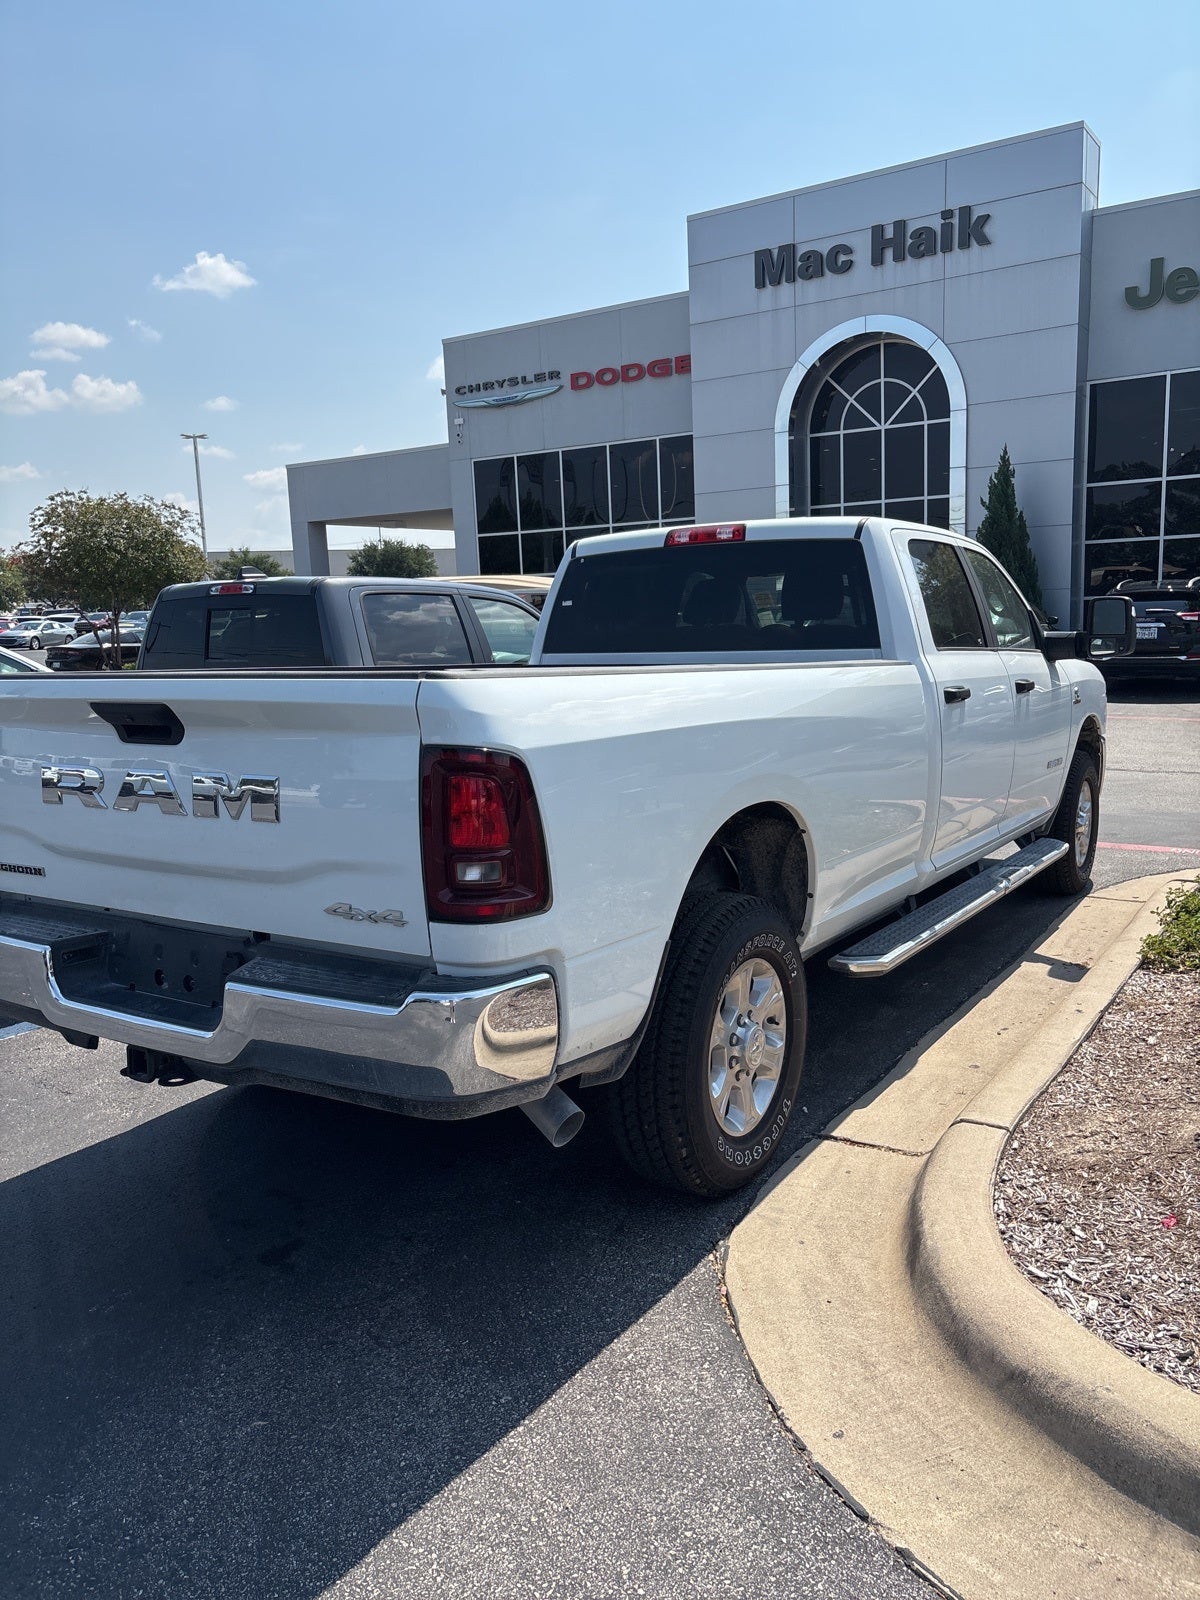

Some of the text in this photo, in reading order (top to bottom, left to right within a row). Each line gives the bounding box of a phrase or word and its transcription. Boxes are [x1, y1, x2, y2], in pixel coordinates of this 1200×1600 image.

[754, 205, 992, 290] Mac Haik
[1125, 257, 1200, 310] Je
[455, 370, 562, 395] CHRYSLER
[570, 354, 691, 391] DODGE
[41, 764, 281, 823] RAM
